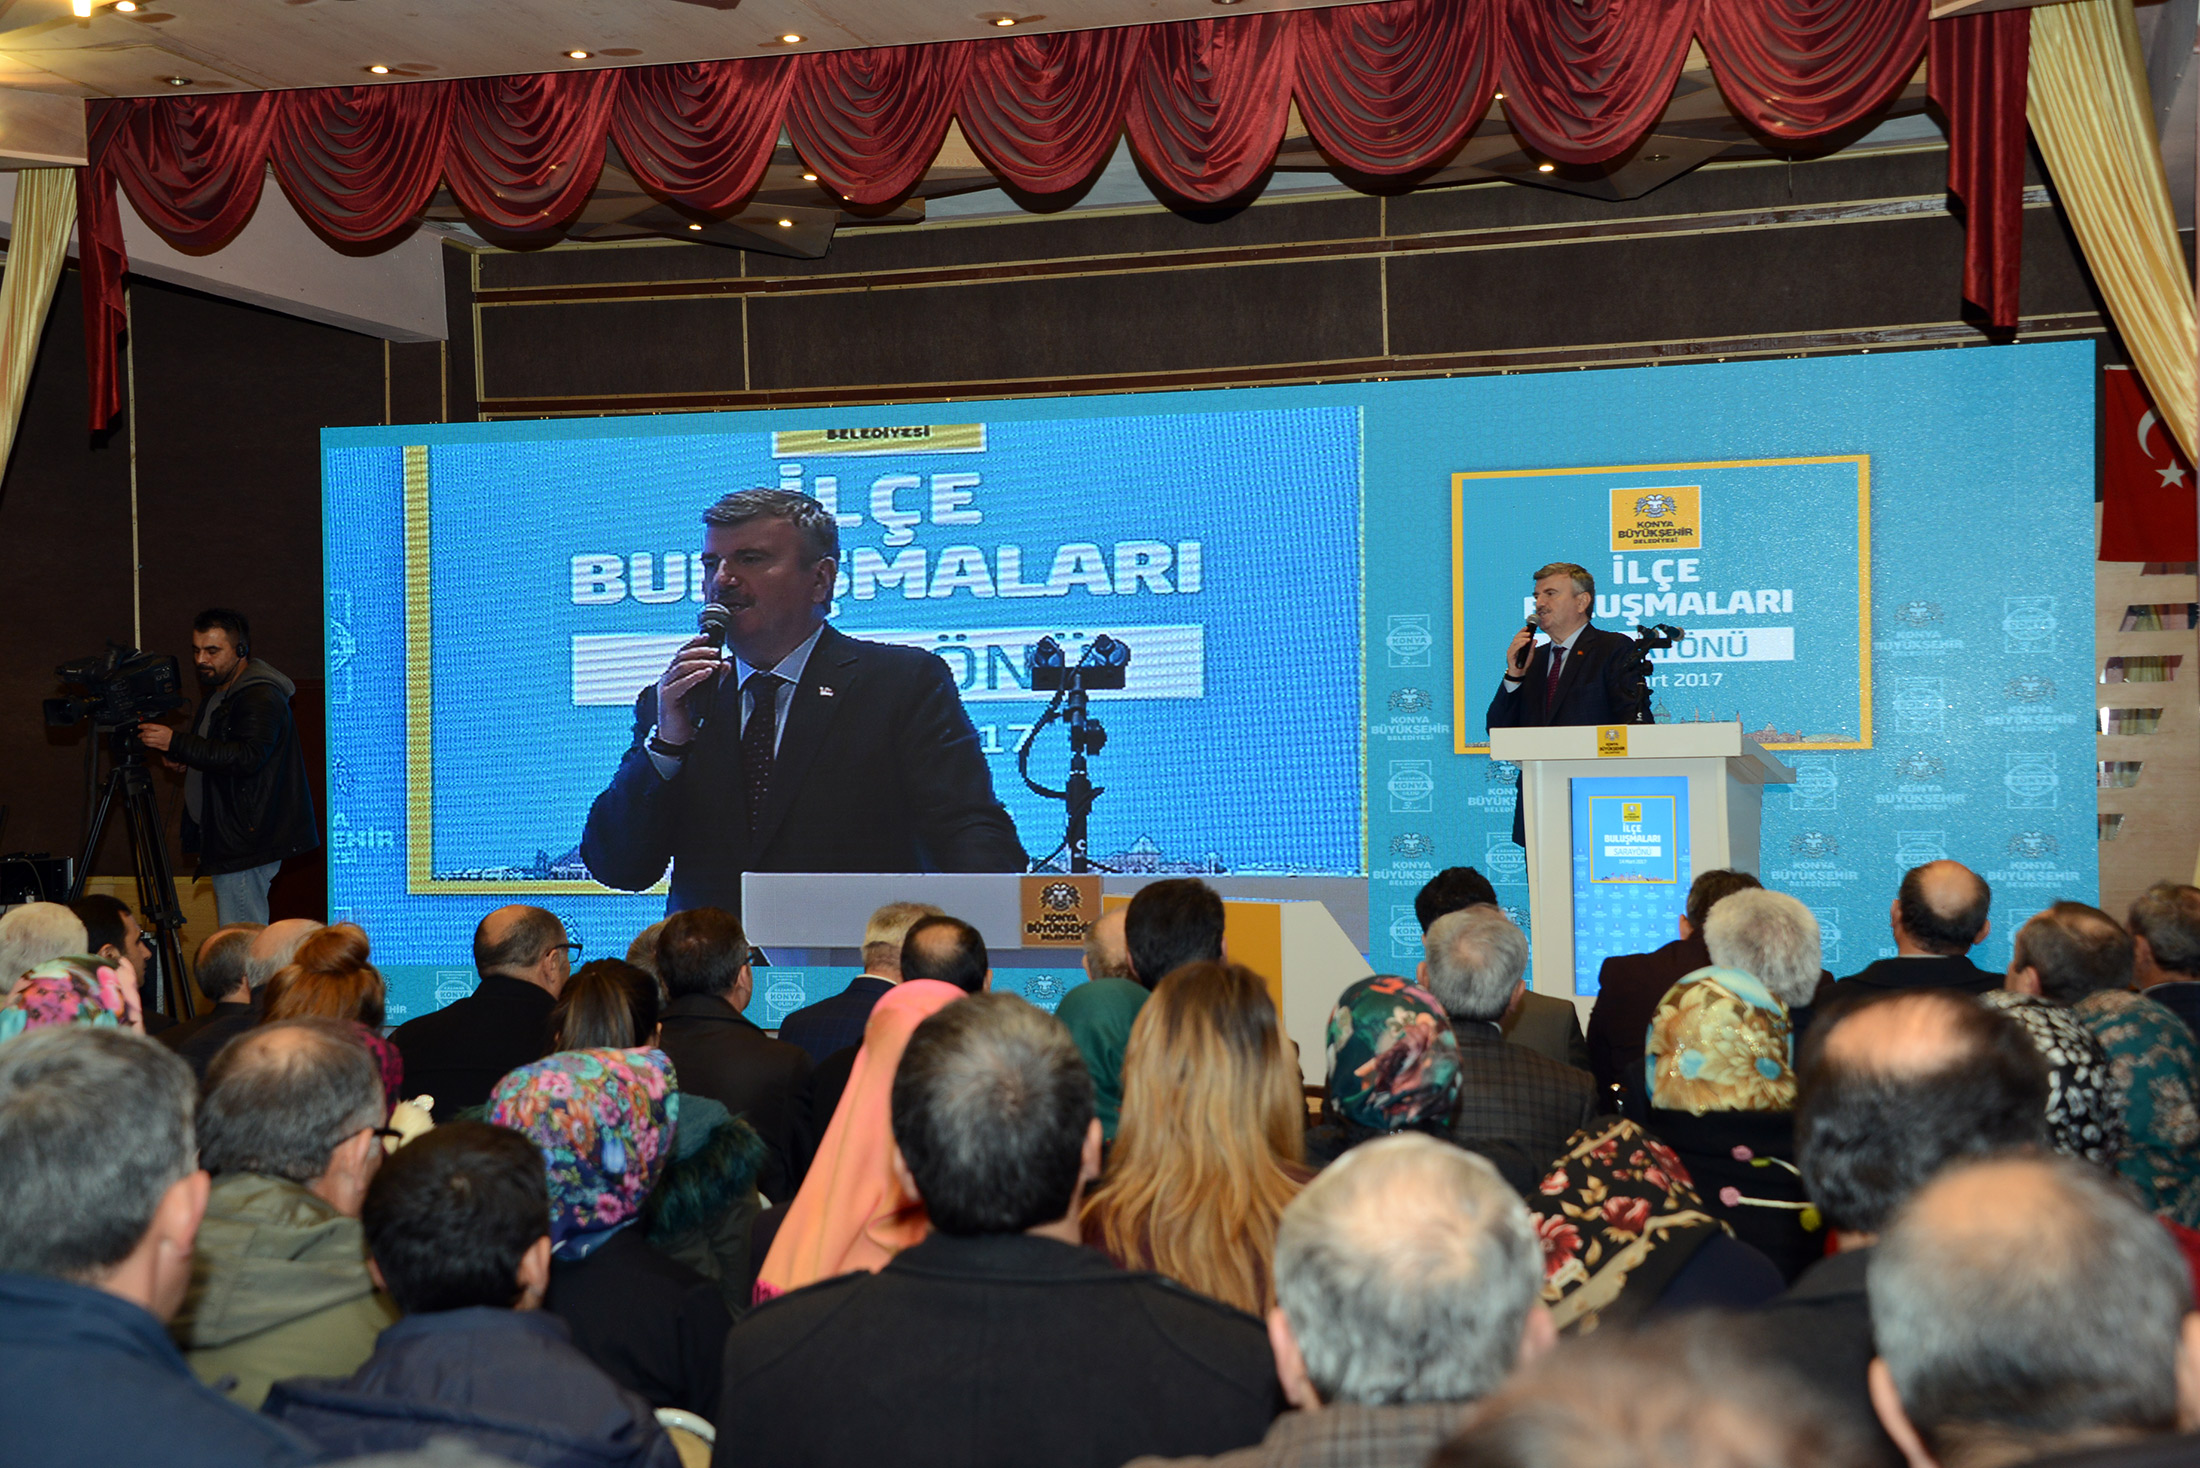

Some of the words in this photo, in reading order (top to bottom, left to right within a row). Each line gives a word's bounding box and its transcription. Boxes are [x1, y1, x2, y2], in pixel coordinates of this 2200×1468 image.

[1636, 520, 1674, 529] KONYA
[1617, 526, 1693, 539] BÜYÜKŞEHİR
[1612, 554, 1700, 592] İLÇE
[1673, 673, 1723, 687] 2017
[1390, 716, 1430, 725] KONYA
[1371, 722, 1450, 735] BÜYÜKŞEHİR
[1393, 782, 1429, 790] KONYA
[1488, 788, 1518, 796] KONY
[1468, 795, 1517, 806] BÜYÜKŞ
[1622, 823, 1642, 835] İLÇE
[1604, 834, 1661, 845] BULUŞMALARI
[1393, 861, 1432, 870] KONYA
[2009, 861, 2056, 870] KONYA
[1373, 868, 1439, 880] BÜYÜKŞEH
[1395, 926, 1424, 935] KONY
